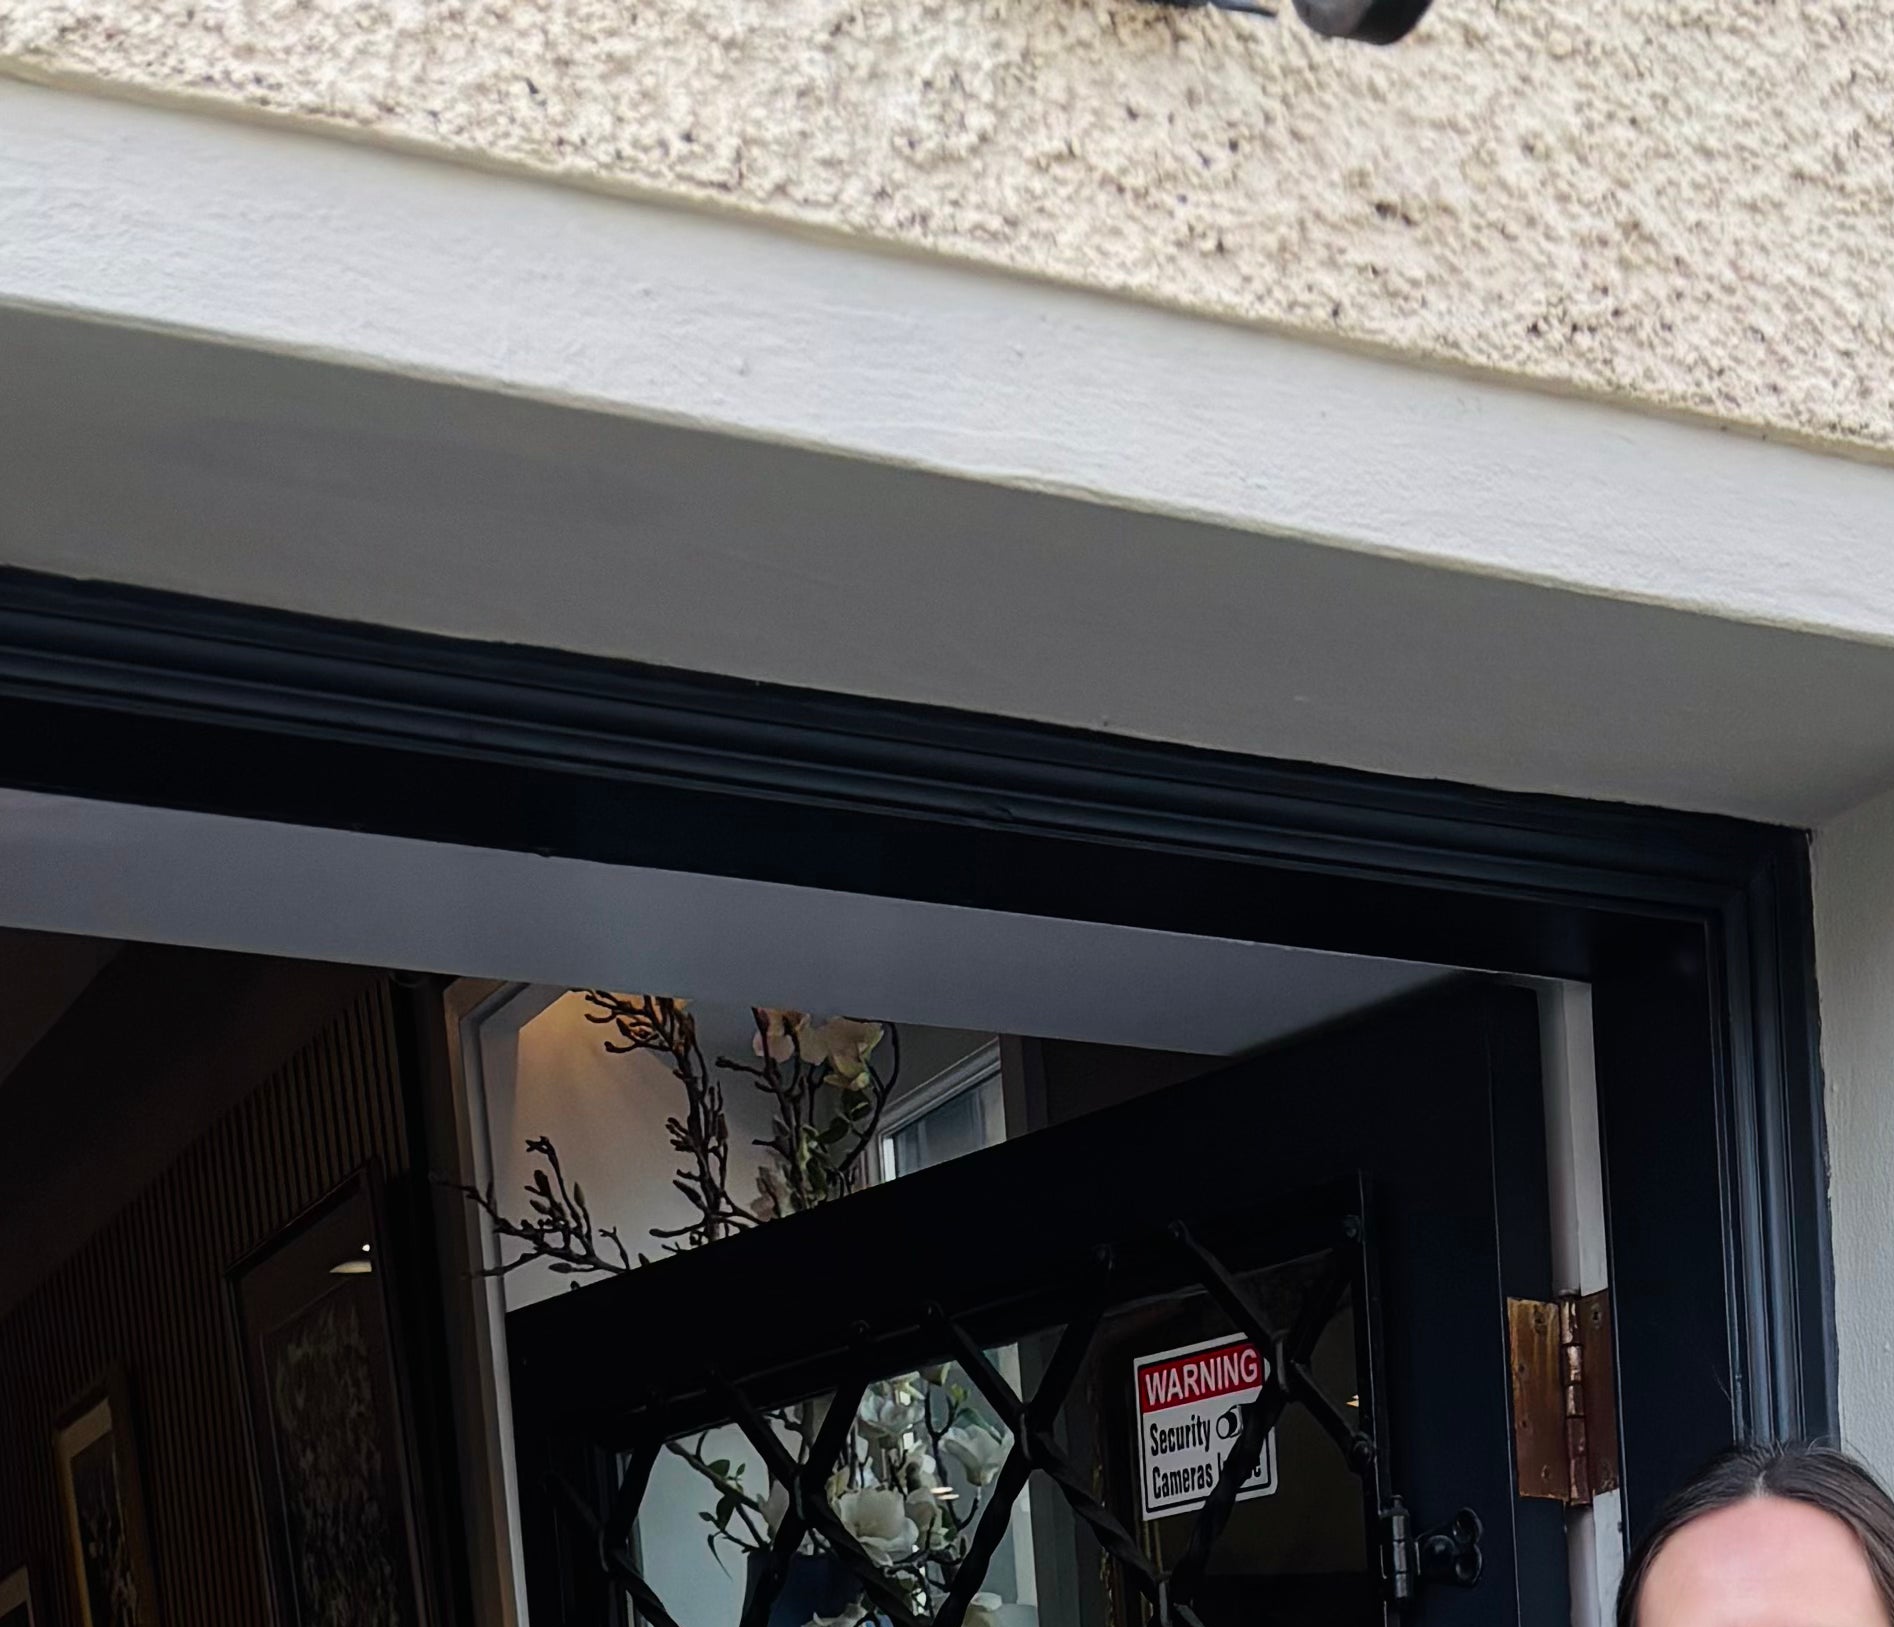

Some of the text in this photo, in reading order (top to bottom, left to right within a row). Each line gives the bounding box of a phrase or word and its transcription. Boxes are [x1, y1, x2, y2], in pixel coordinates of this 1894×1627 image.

[1146, 1348, 1258, 1406] WARNING
[1150, 1414, 1211, 1456] Security
[1152, 1463, 1213, 1499] Cameras
